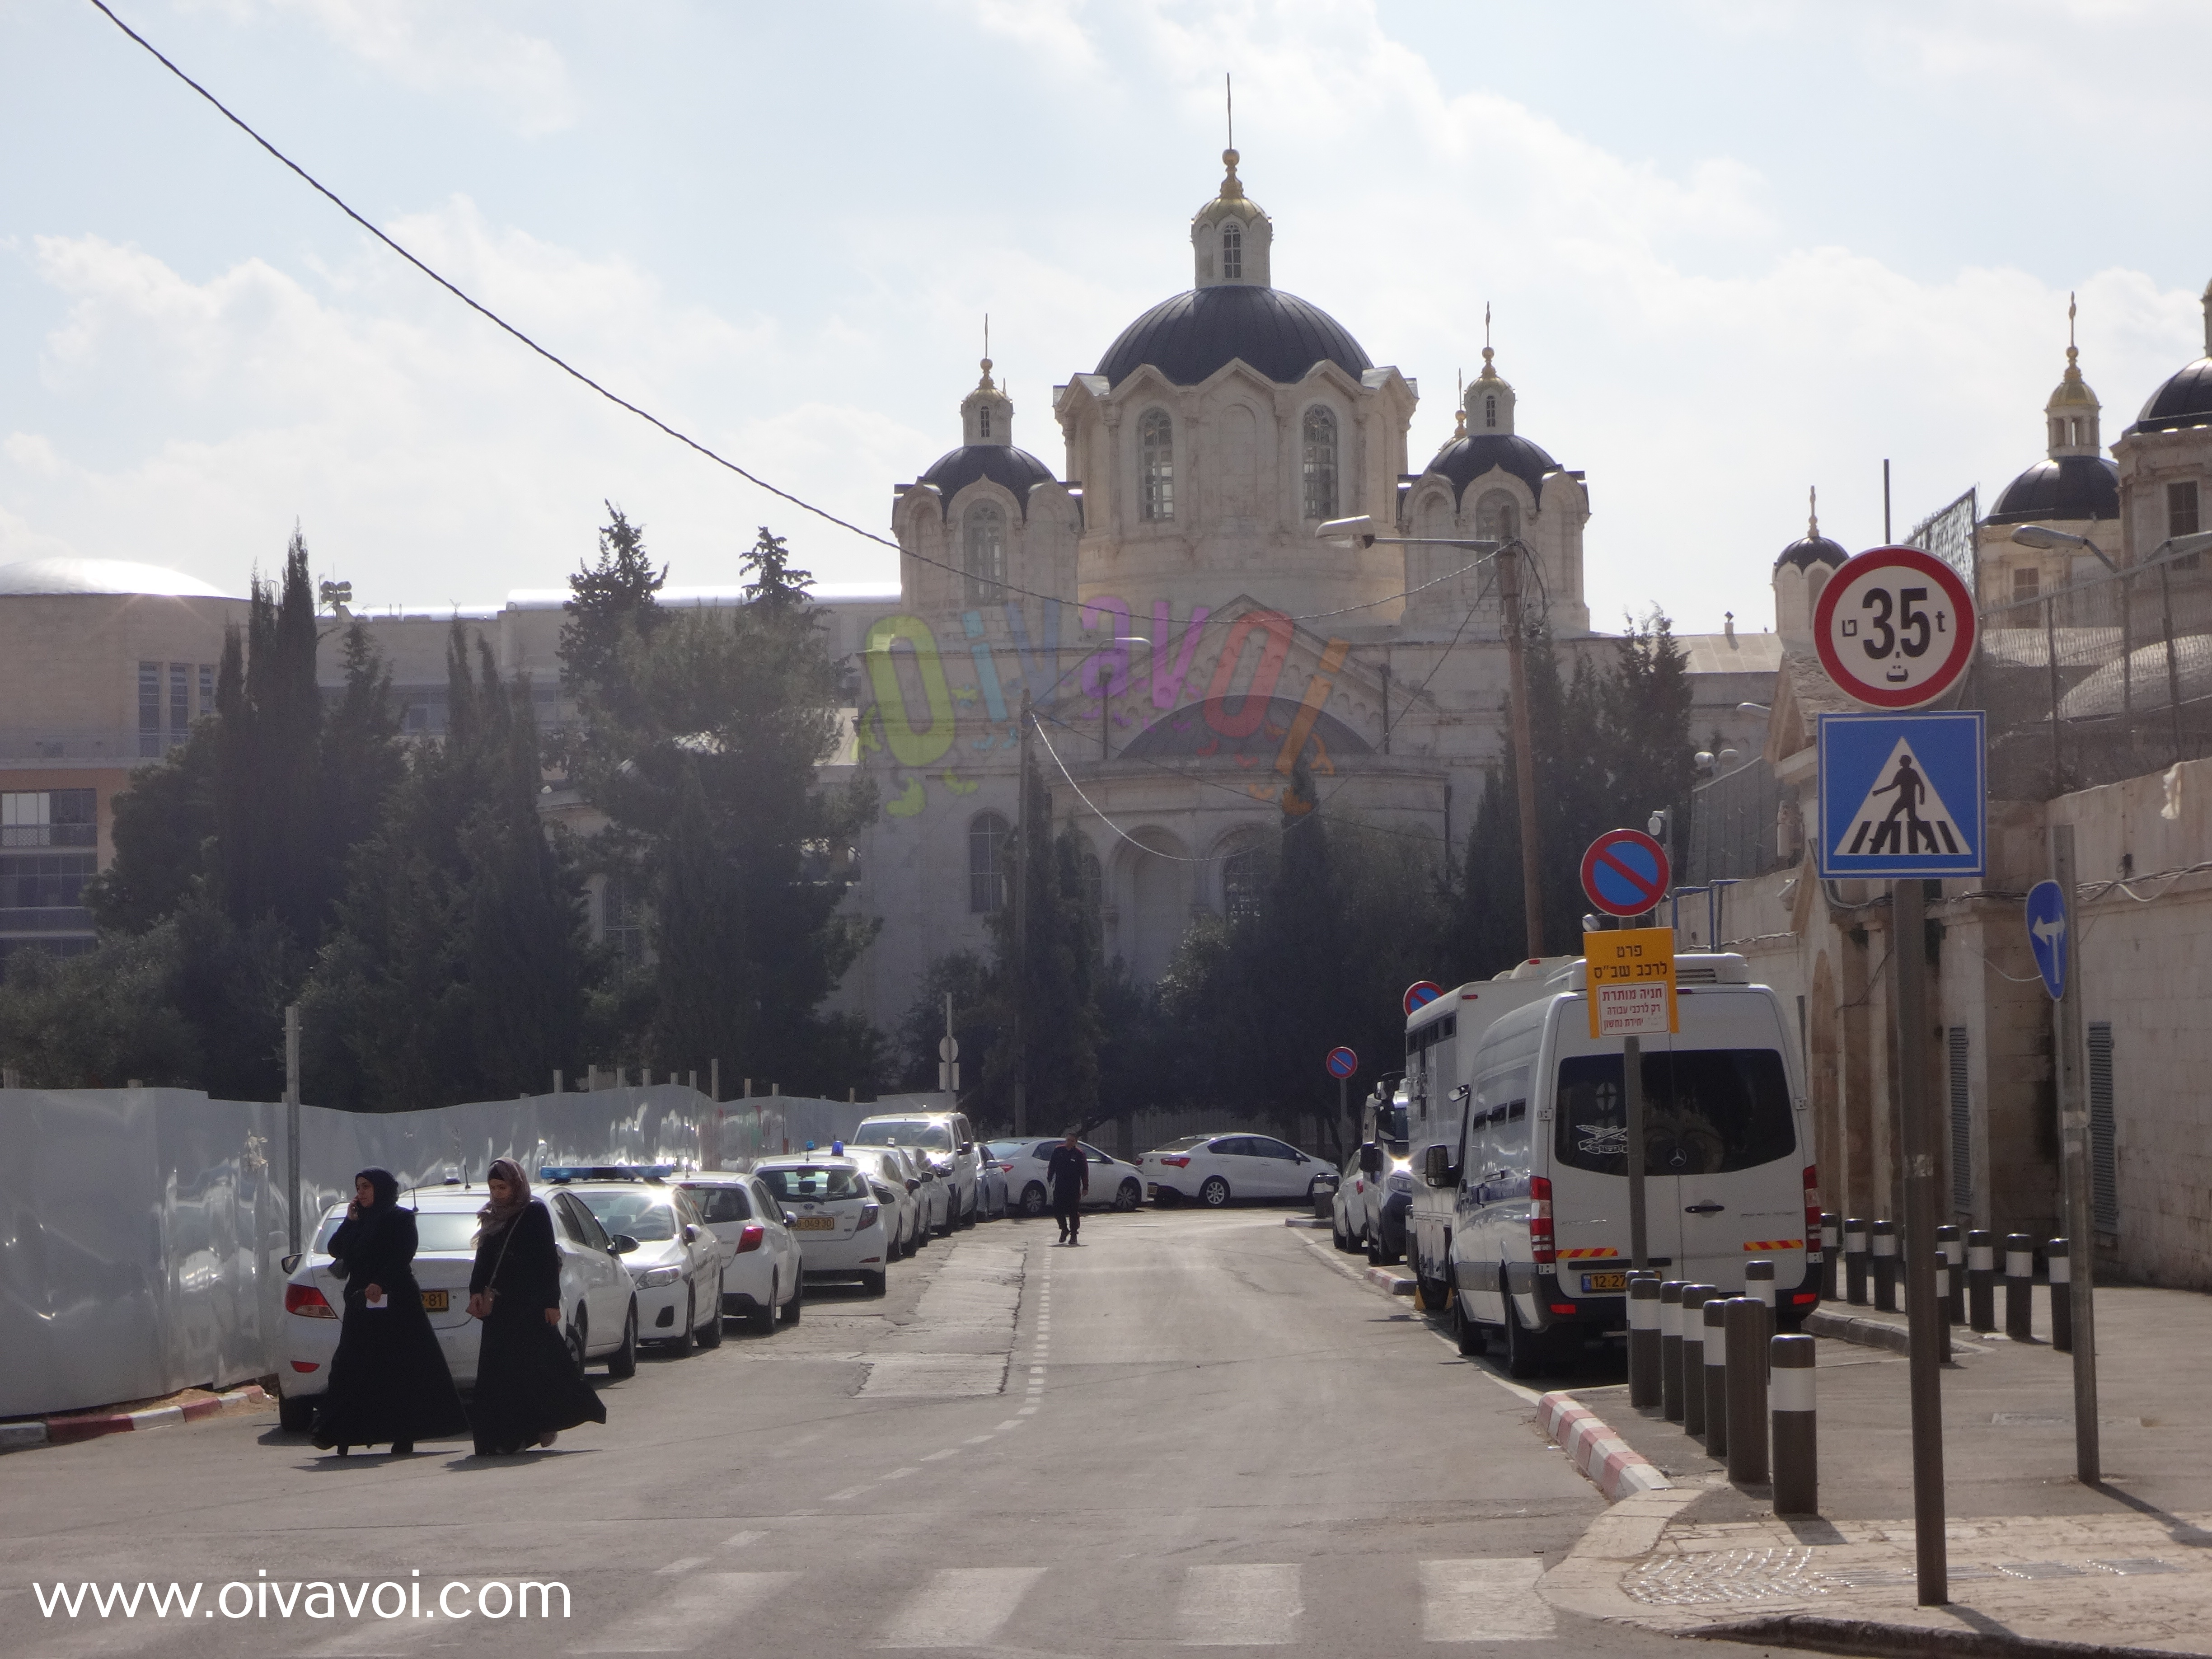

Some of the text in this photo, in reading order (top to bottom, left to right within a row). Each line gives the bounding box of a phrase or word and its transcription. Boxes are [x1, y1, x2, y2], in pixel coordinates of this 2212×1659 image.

[1862, 587, 1931, 660] 3.5
[1935, 610, 1946, 633] t
[1616, 945, 1643, 958] פרט
[1636, 961, 1668, 976] לרכב
[1602, 988, 1663, 1002] חניה מותרת
[1607, 1006, 1628, 1015] עבודה
[1651, 1004, 1661, 1016] רק
